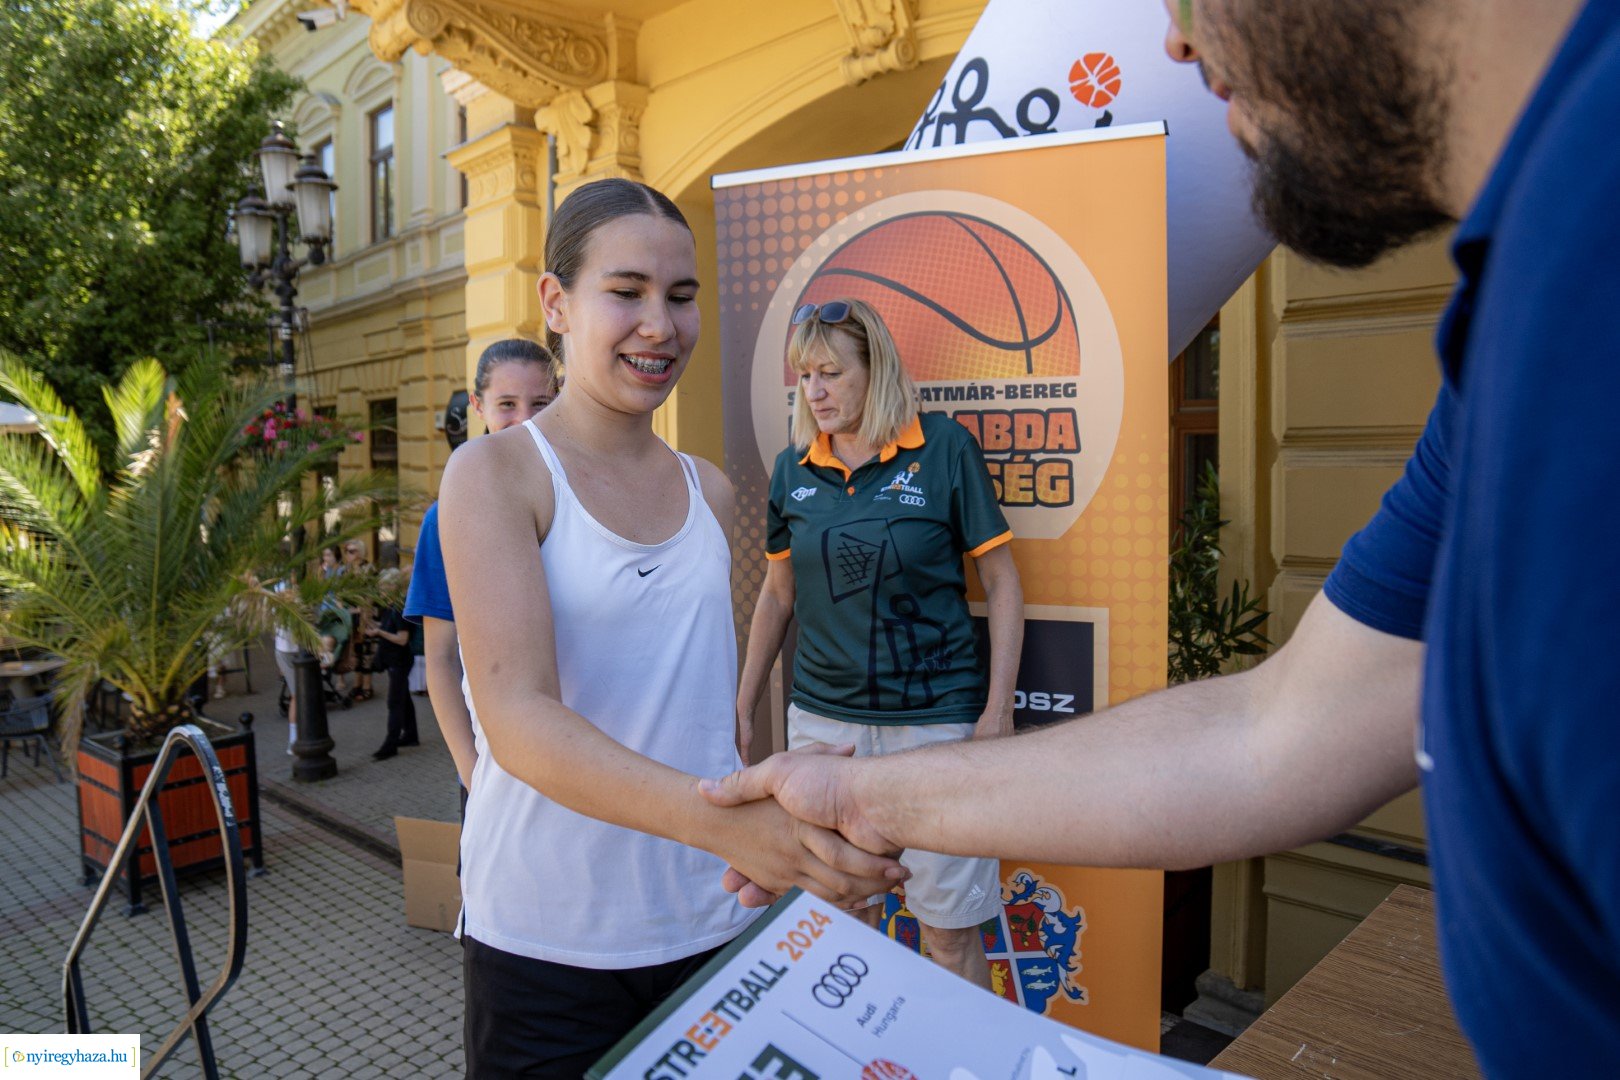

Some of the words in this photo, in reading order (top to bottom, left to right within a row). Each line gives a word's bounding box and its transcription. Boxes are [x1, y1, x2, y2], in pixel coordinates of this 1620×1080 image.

[920, 383, 1077, 402] ATMÁR-BEREG
[953, 408, 1081, 454] ABDA
[776, 908, 833, 962] 2024
[856, 1003, 877, 1028] Audi
[871, 996, 906, 1038] Hungaria
